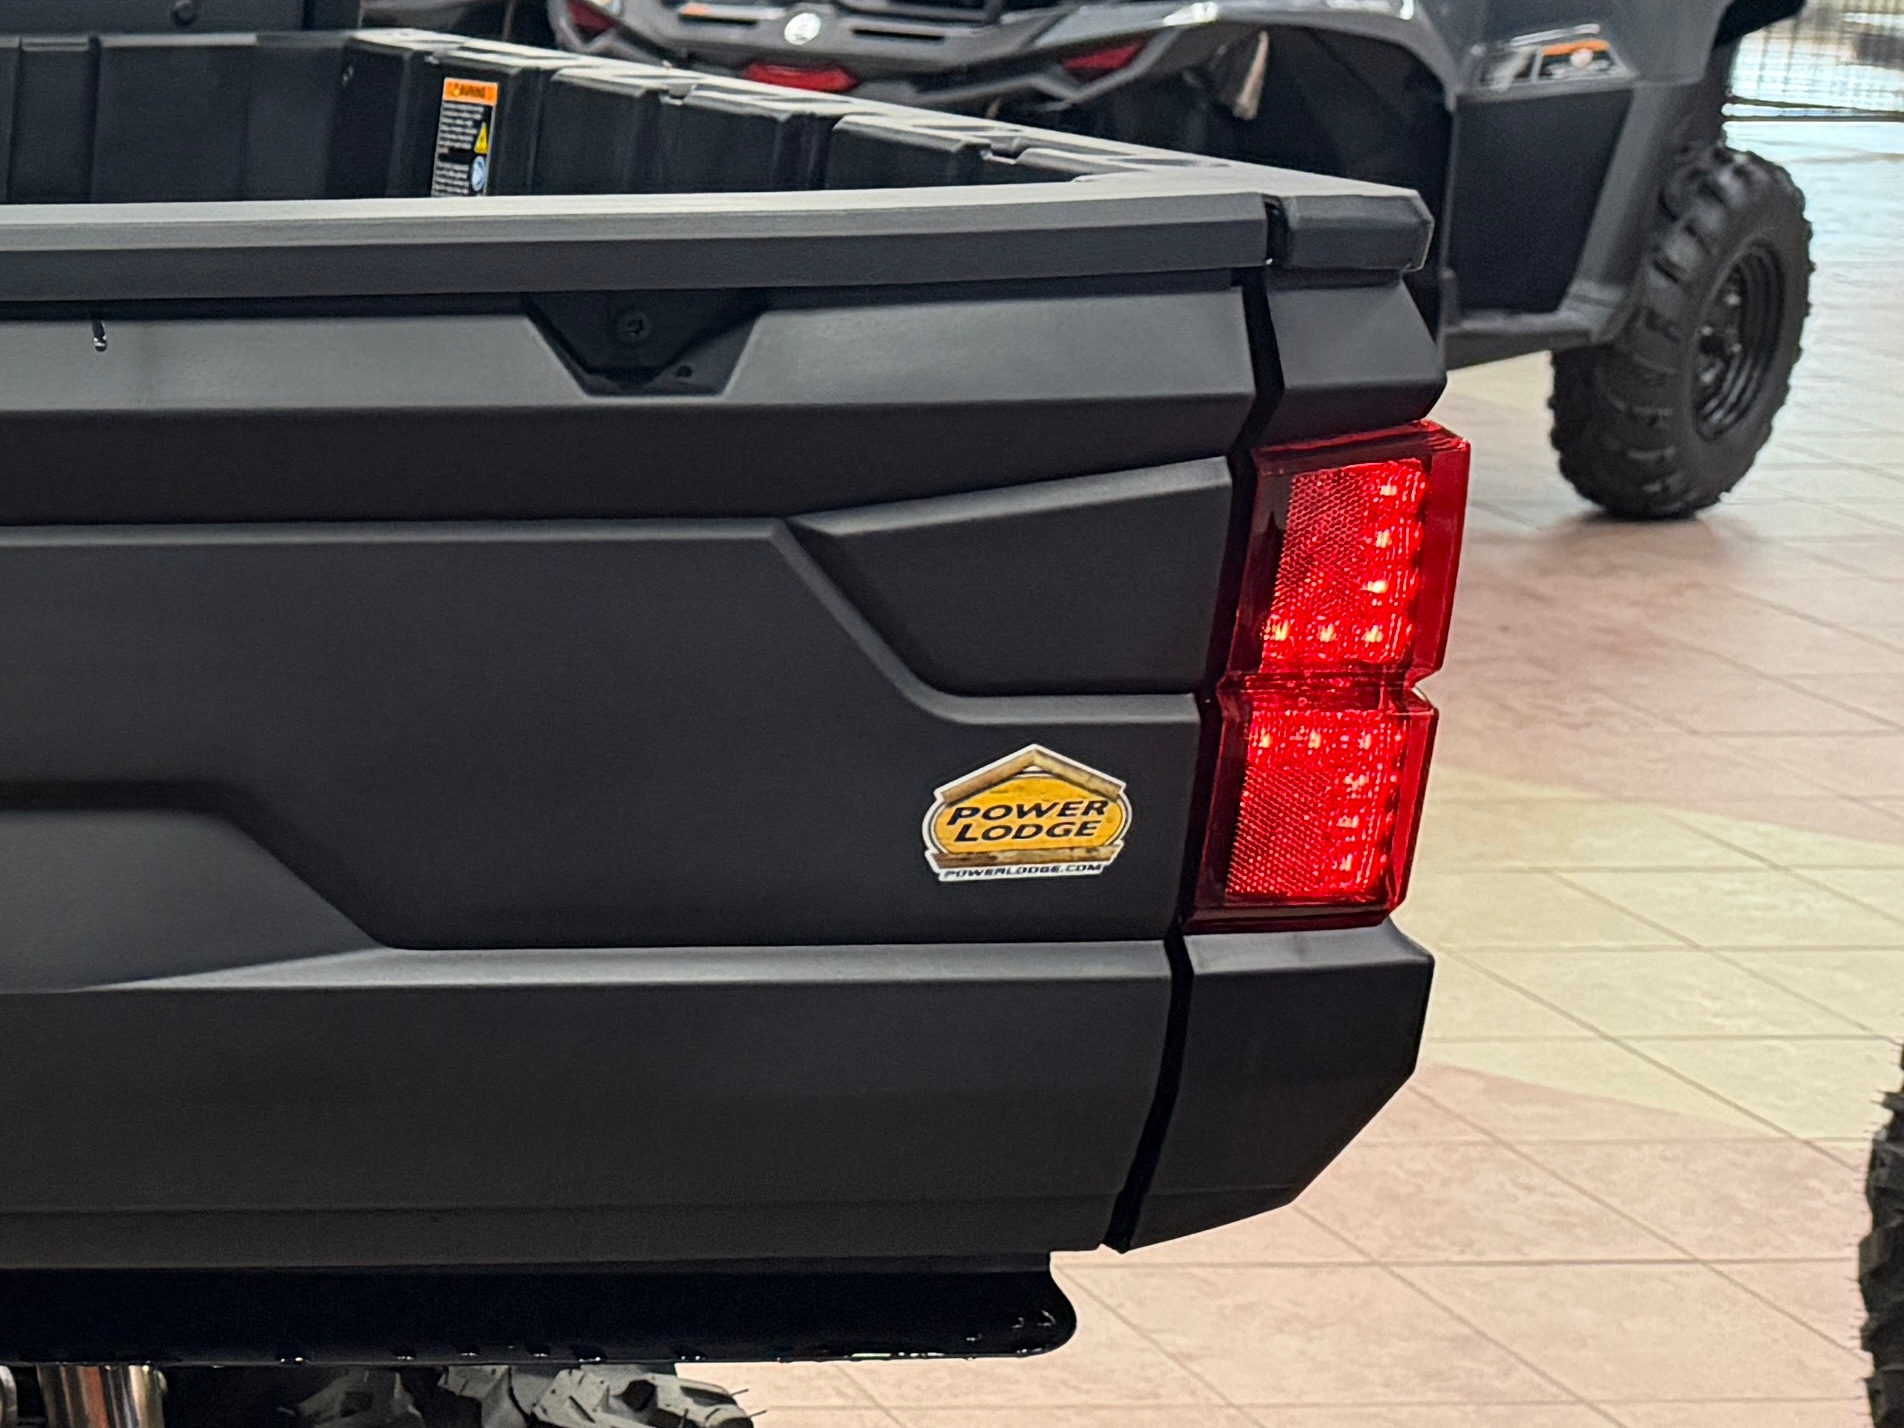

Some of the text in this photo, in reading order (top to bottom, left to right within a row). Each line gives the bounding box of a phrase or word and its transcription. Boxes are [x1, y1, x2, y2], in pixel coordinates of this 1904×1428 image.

[947, 800, 1109, 826] POWER
[954, 819, 1102, 843] LODGE
[943, 863, 1103, 879] POWERLODGE.COM
